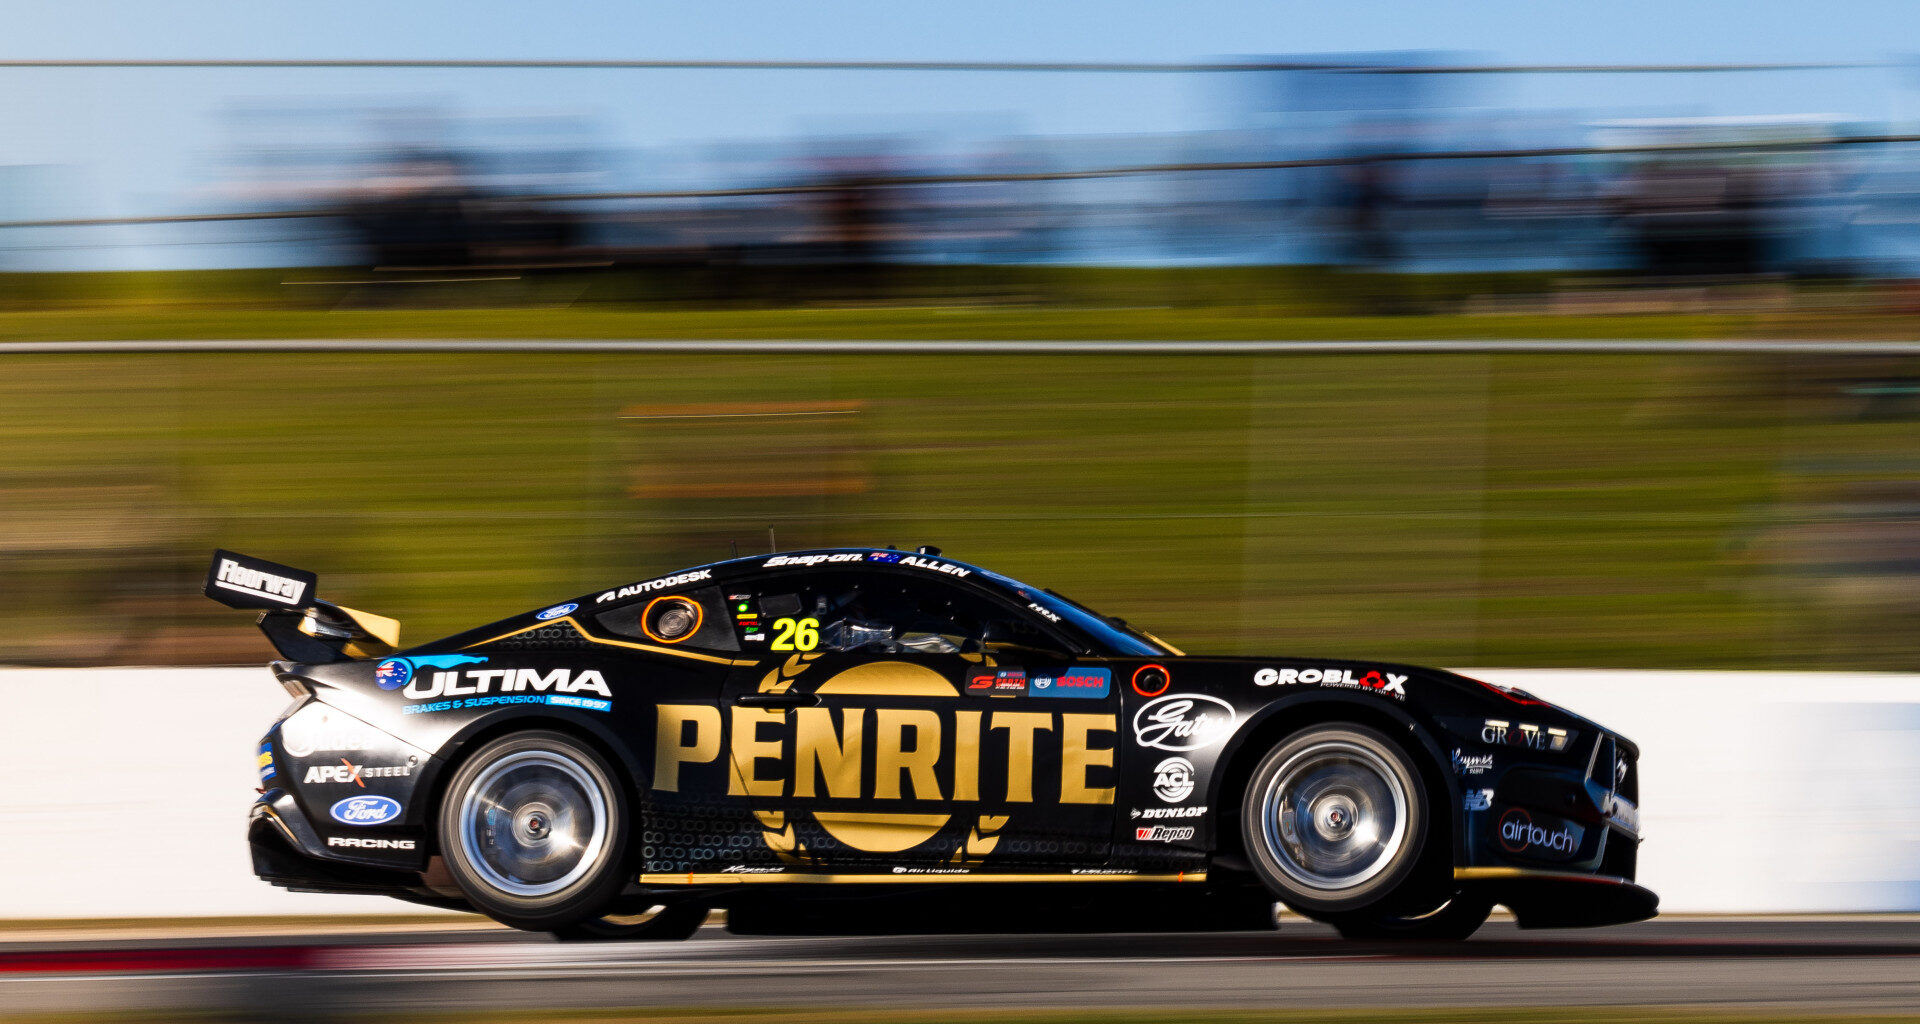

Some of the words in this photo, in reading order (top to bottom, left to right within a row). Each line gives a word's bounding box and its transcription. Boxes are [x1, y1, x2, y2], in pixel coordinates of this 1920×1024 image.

[762, 553, 861, 567] Snap-on
[899, 556, 972, 578] ALLEN
[216, 558, 307, 604] Floorway
[618, 569, 712, 598] AUTODESK
[770, 617, 820, 651] 26
[402, 668, 613, 700] ULTIMA
[1056, 675, 1104, 688] BOSCH
[402, 700, 452, 715] BRAKES
[452, 701, 463, 709] &
[465, 694, 546, 708] SUSPENSION
[550, 696, 582, 706] SINCE
[582, 699, 609, 710] 1997
[1481, 725, 1546, 750] GROVE
[652, 703, 1118, 805] PENRITE
[303, 758, 366, 789] APEX
[364, 766, 411, 778] STEEL
[1153, 772, 1195, 788] ACL
[1141, 806, 1208, 819] DUNLOP
[327, 836, 416, 850] RACING
[1150, 825, 1194, 843] Repco
[1502, 819, 1573, 853] airtouch
